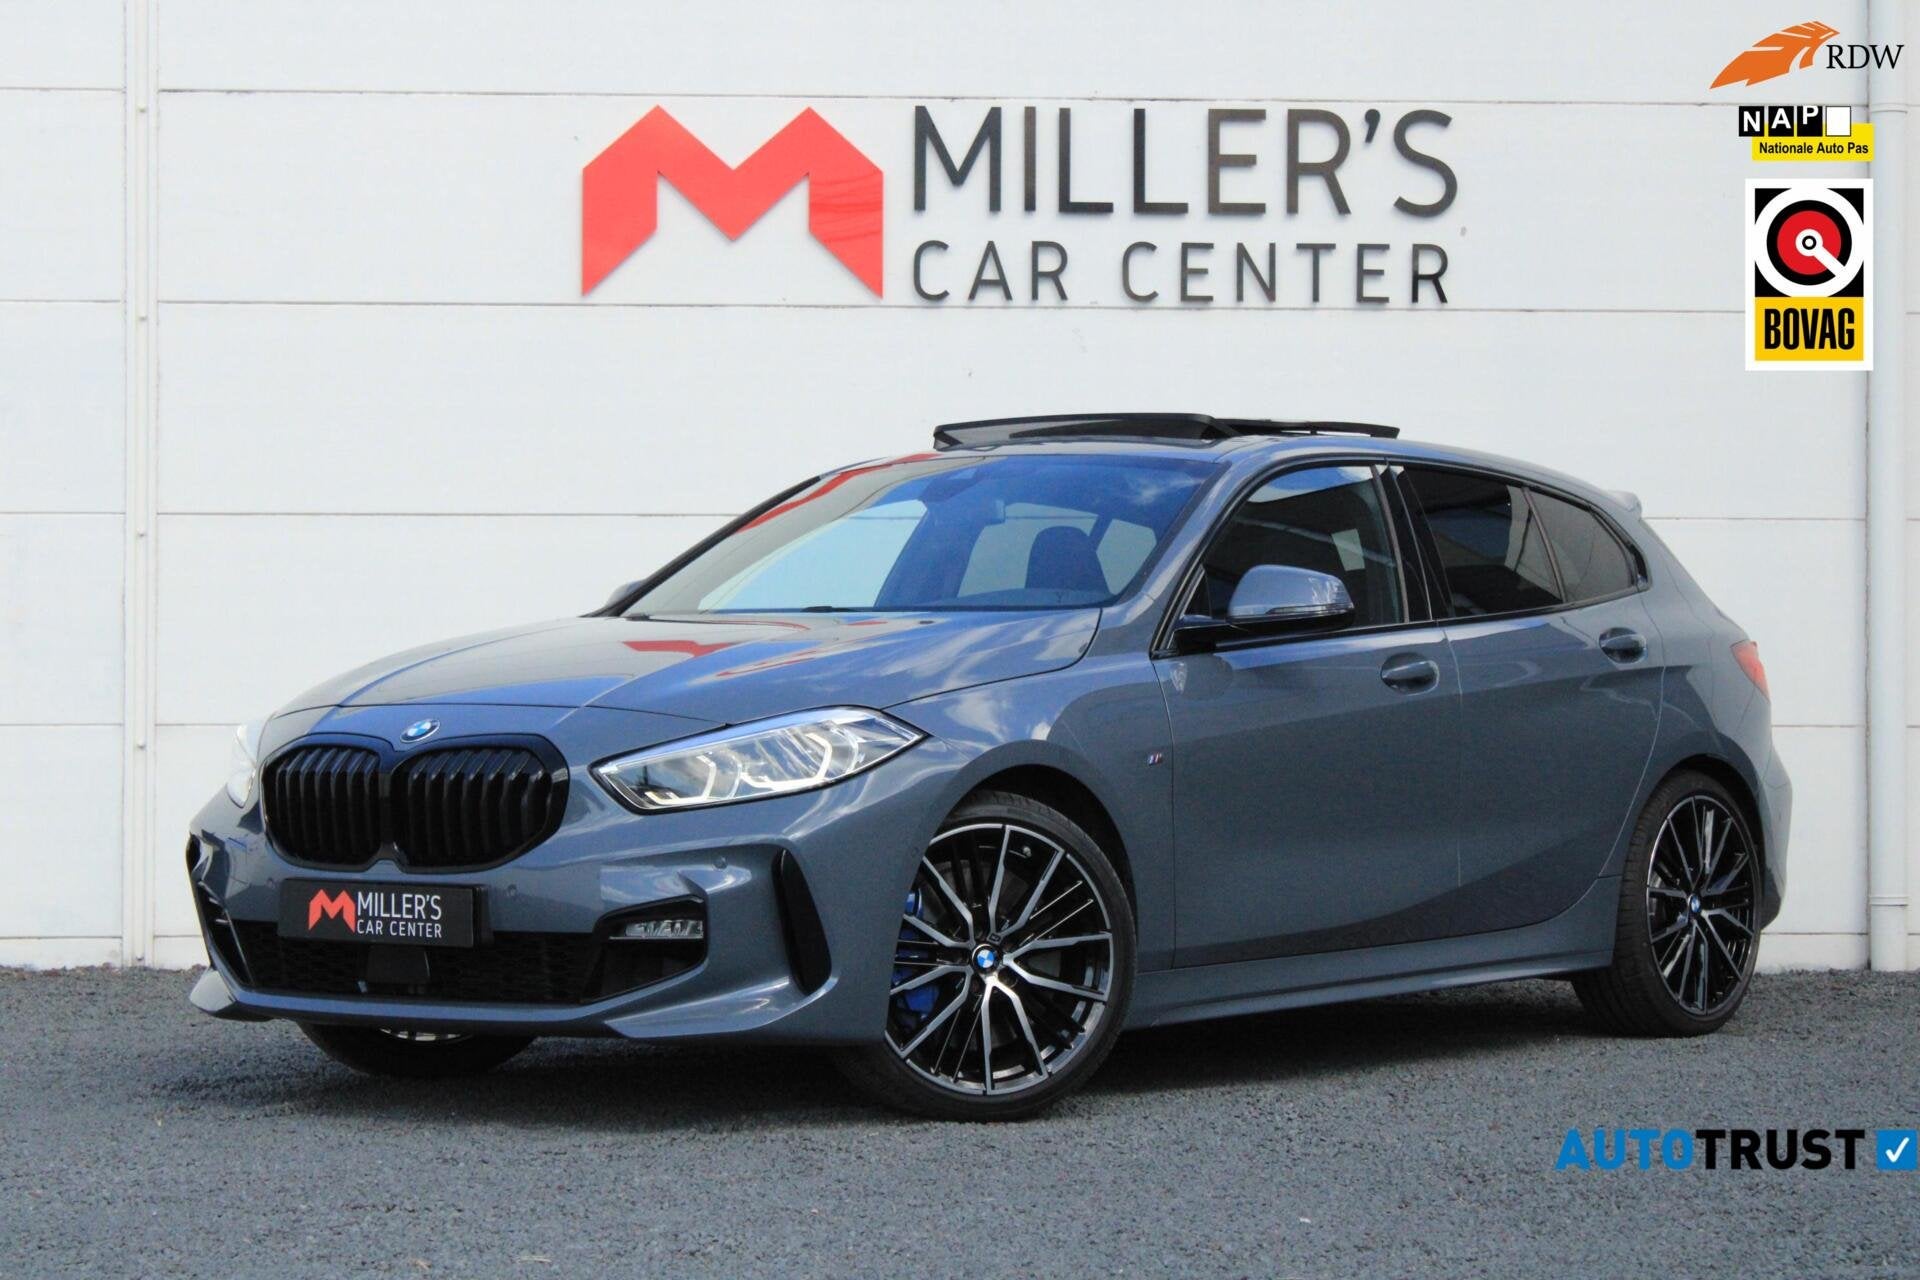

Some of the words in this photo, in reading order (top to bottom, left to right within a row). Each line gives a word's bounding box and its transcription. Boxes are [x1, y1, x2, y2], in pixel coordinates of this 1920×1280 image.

[913, 105, 1458, 217] MILLER'S
[912, 240, 1069, 301] CAR
[1121, 241, 1449, 303] CENTER
[357, 891, 442, 921] MILLER'S
[357, 919, 384, 935] CAR
[389, 920, 442, 939] CENTER
